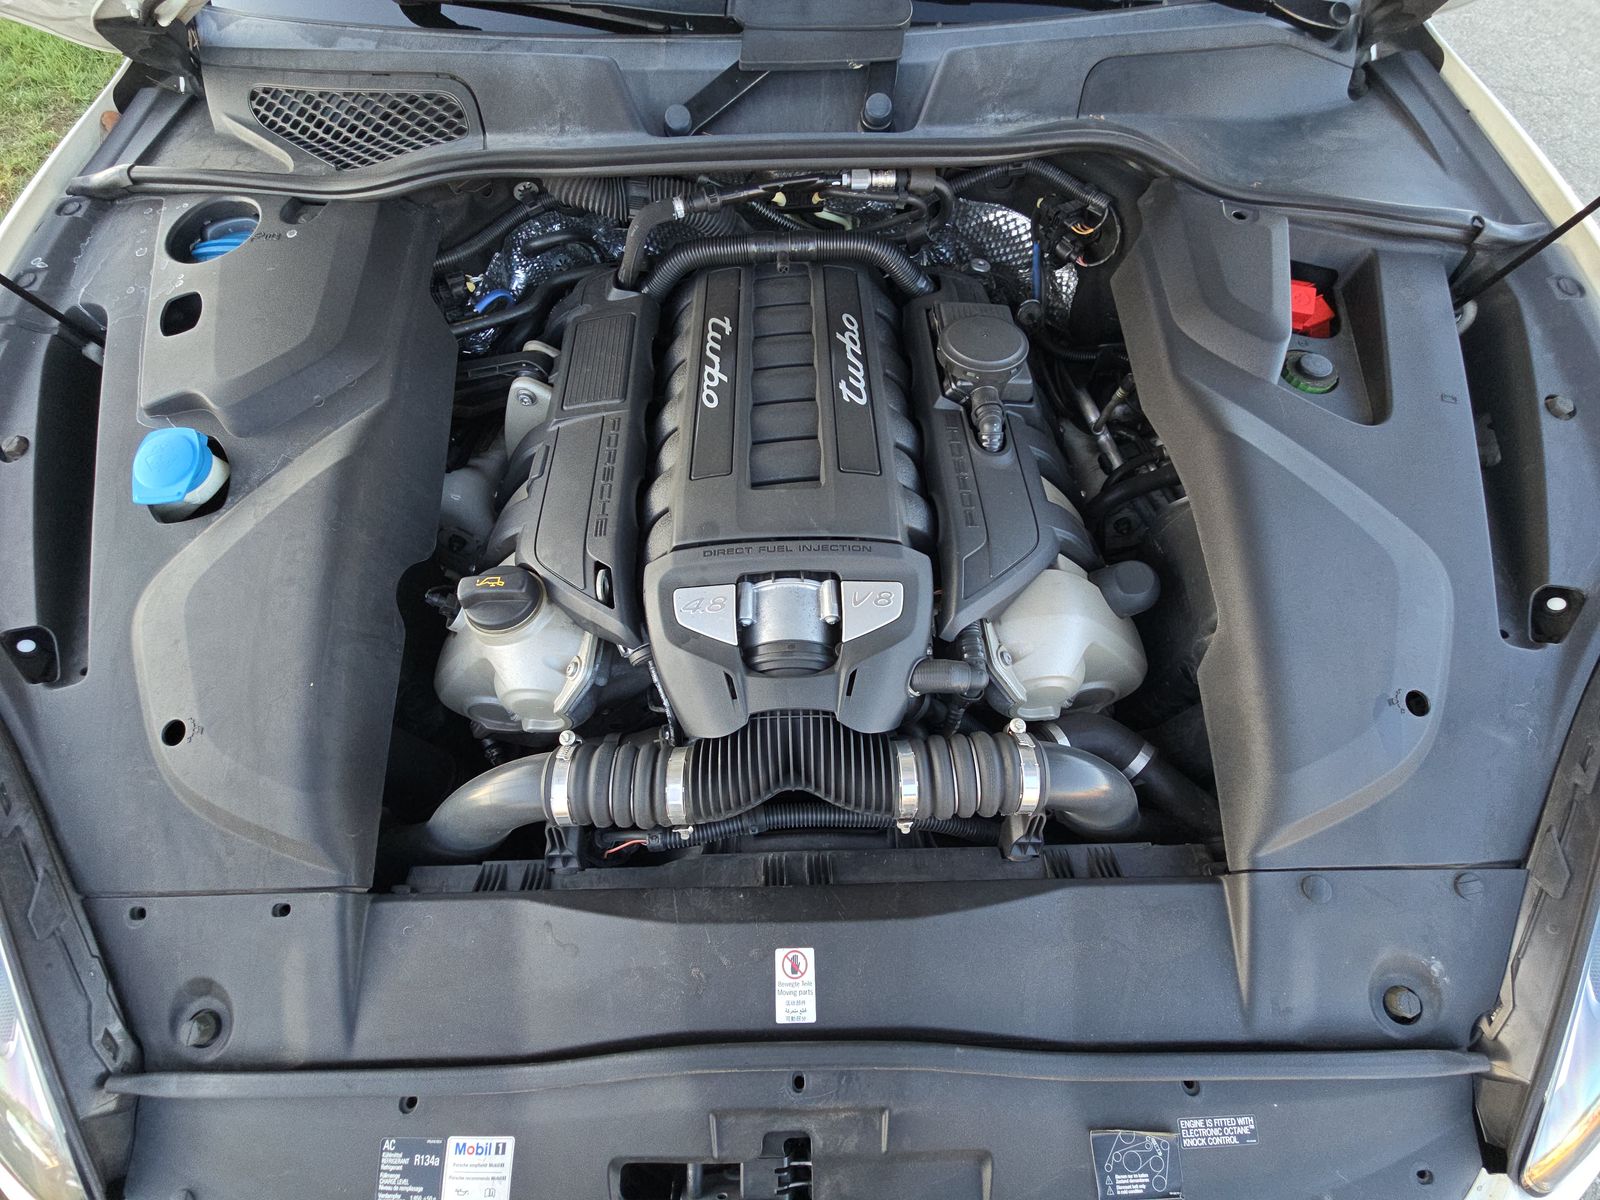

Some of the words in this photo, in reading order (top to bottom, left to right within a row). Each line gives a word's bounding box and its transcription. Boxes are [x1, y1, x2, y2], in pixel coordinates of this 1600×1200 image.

[702, 316, 733, 409] turbo
[835, 313, 868, 406] turbo
[593, 417, 621, 538] PORSCHE
[703, 547, 753, 558] DIRECT
[758, 545, 793, 554] FUEL
[799, 544, 872, 553] INJECTION
[851, 591, 895, 609] V8
[777, 989, 797, 997] Moving
[799, 989, 813, 997] parts
[1180, 1119, 1206, 1128] ENGINE
[1206, 1119, 1213, 1127] IS
[1213, 1118, 1236, 1127] FITTED
[1236, 1116, 1254, 1125] WITH
[1181, 1128, 1223, 1138] ELECTRONIC
[382, 1139, 396, 1151] AC
[1183, 1137, 1207, 1147] KNOCK
[1207, 1136, 1240, 1146] CONTROL
[455, 1142, 492, 1156] Mobil
[413, 1154, 440, 1166] R134a
